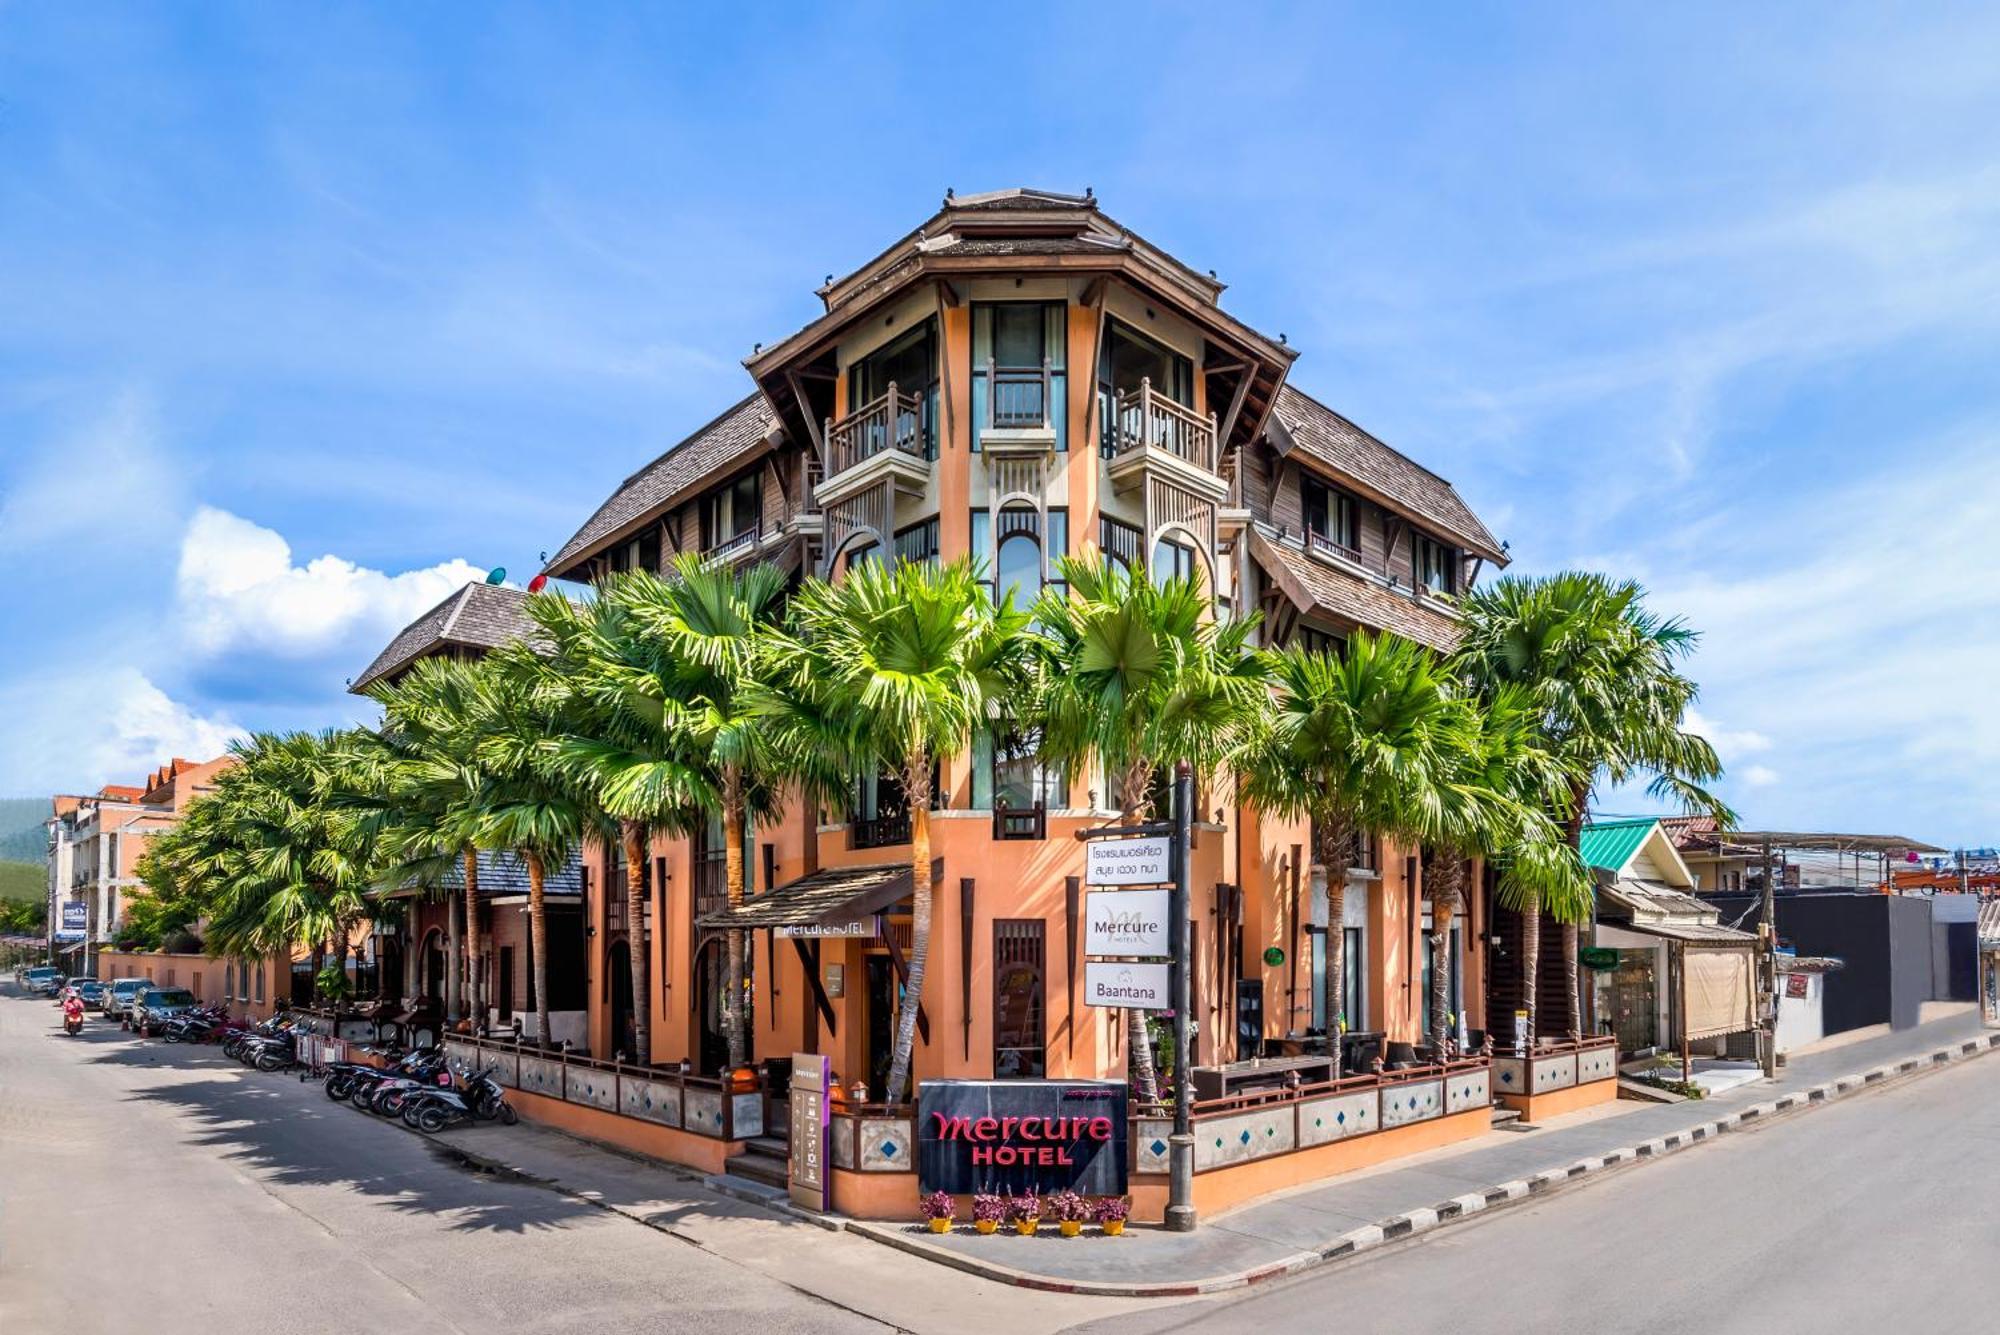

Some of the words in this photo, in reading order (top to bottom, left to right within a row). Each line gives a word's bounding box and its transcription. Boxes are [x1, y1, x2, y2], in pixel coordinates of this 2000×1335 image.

[1095, 921, 1159, 933] Mercure
[1096, 982, 1156, 999] Baantana
[972, 1146, 1074, 1166] HOTEL
